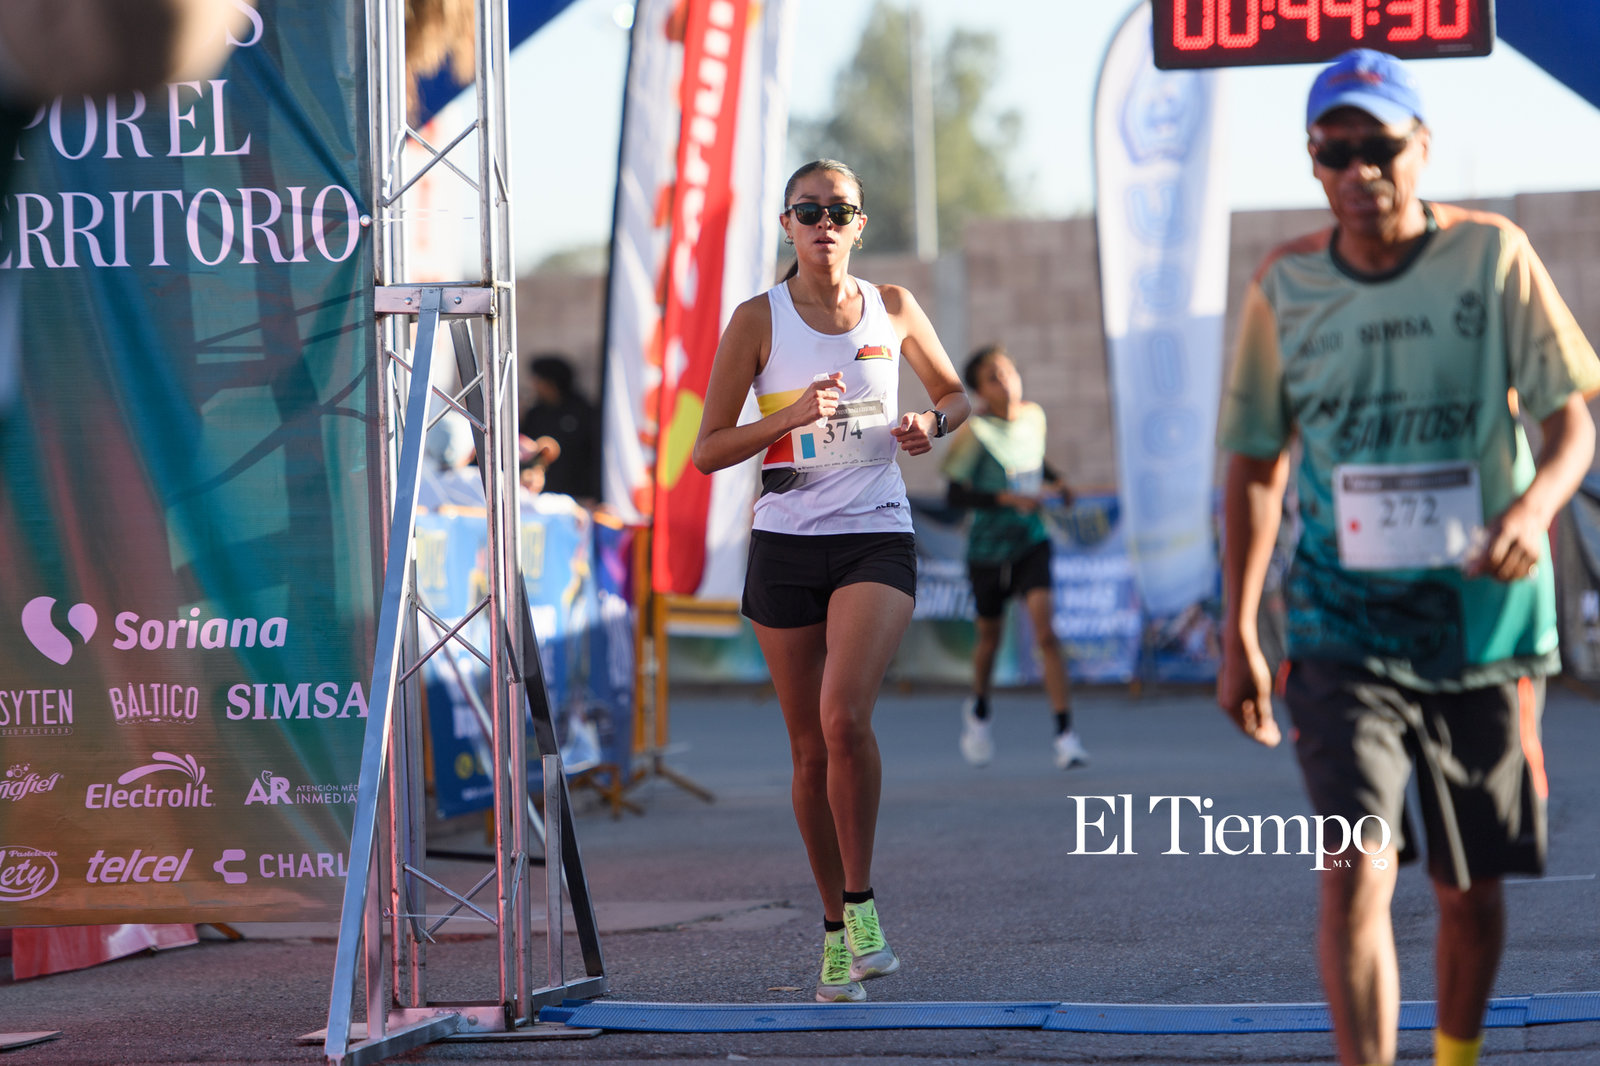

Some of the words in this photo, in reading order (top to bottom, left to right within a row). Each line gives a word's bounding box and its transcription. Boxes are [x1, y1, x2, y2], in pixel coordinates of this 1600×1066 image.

[1172, 0, 1470, 50] 00:44:30
[166, 79, 251, 157] EL
[823, 419, 863, 444] 374
[1379, 495, 1438, 528] 272
[113, 607, 288, 650] Soriana
[0, 689, 73, 726] SYTEN
[226, 682, 369, 720] SIMSA
[85, 783, 213, 809] Electrolit
[244, 777, 293, 805] AR
[296, 783, 338, 791] ATENCIÓN
[86, 849, 193, 883] telcel
[259, 853, 348, 878] CHARL
